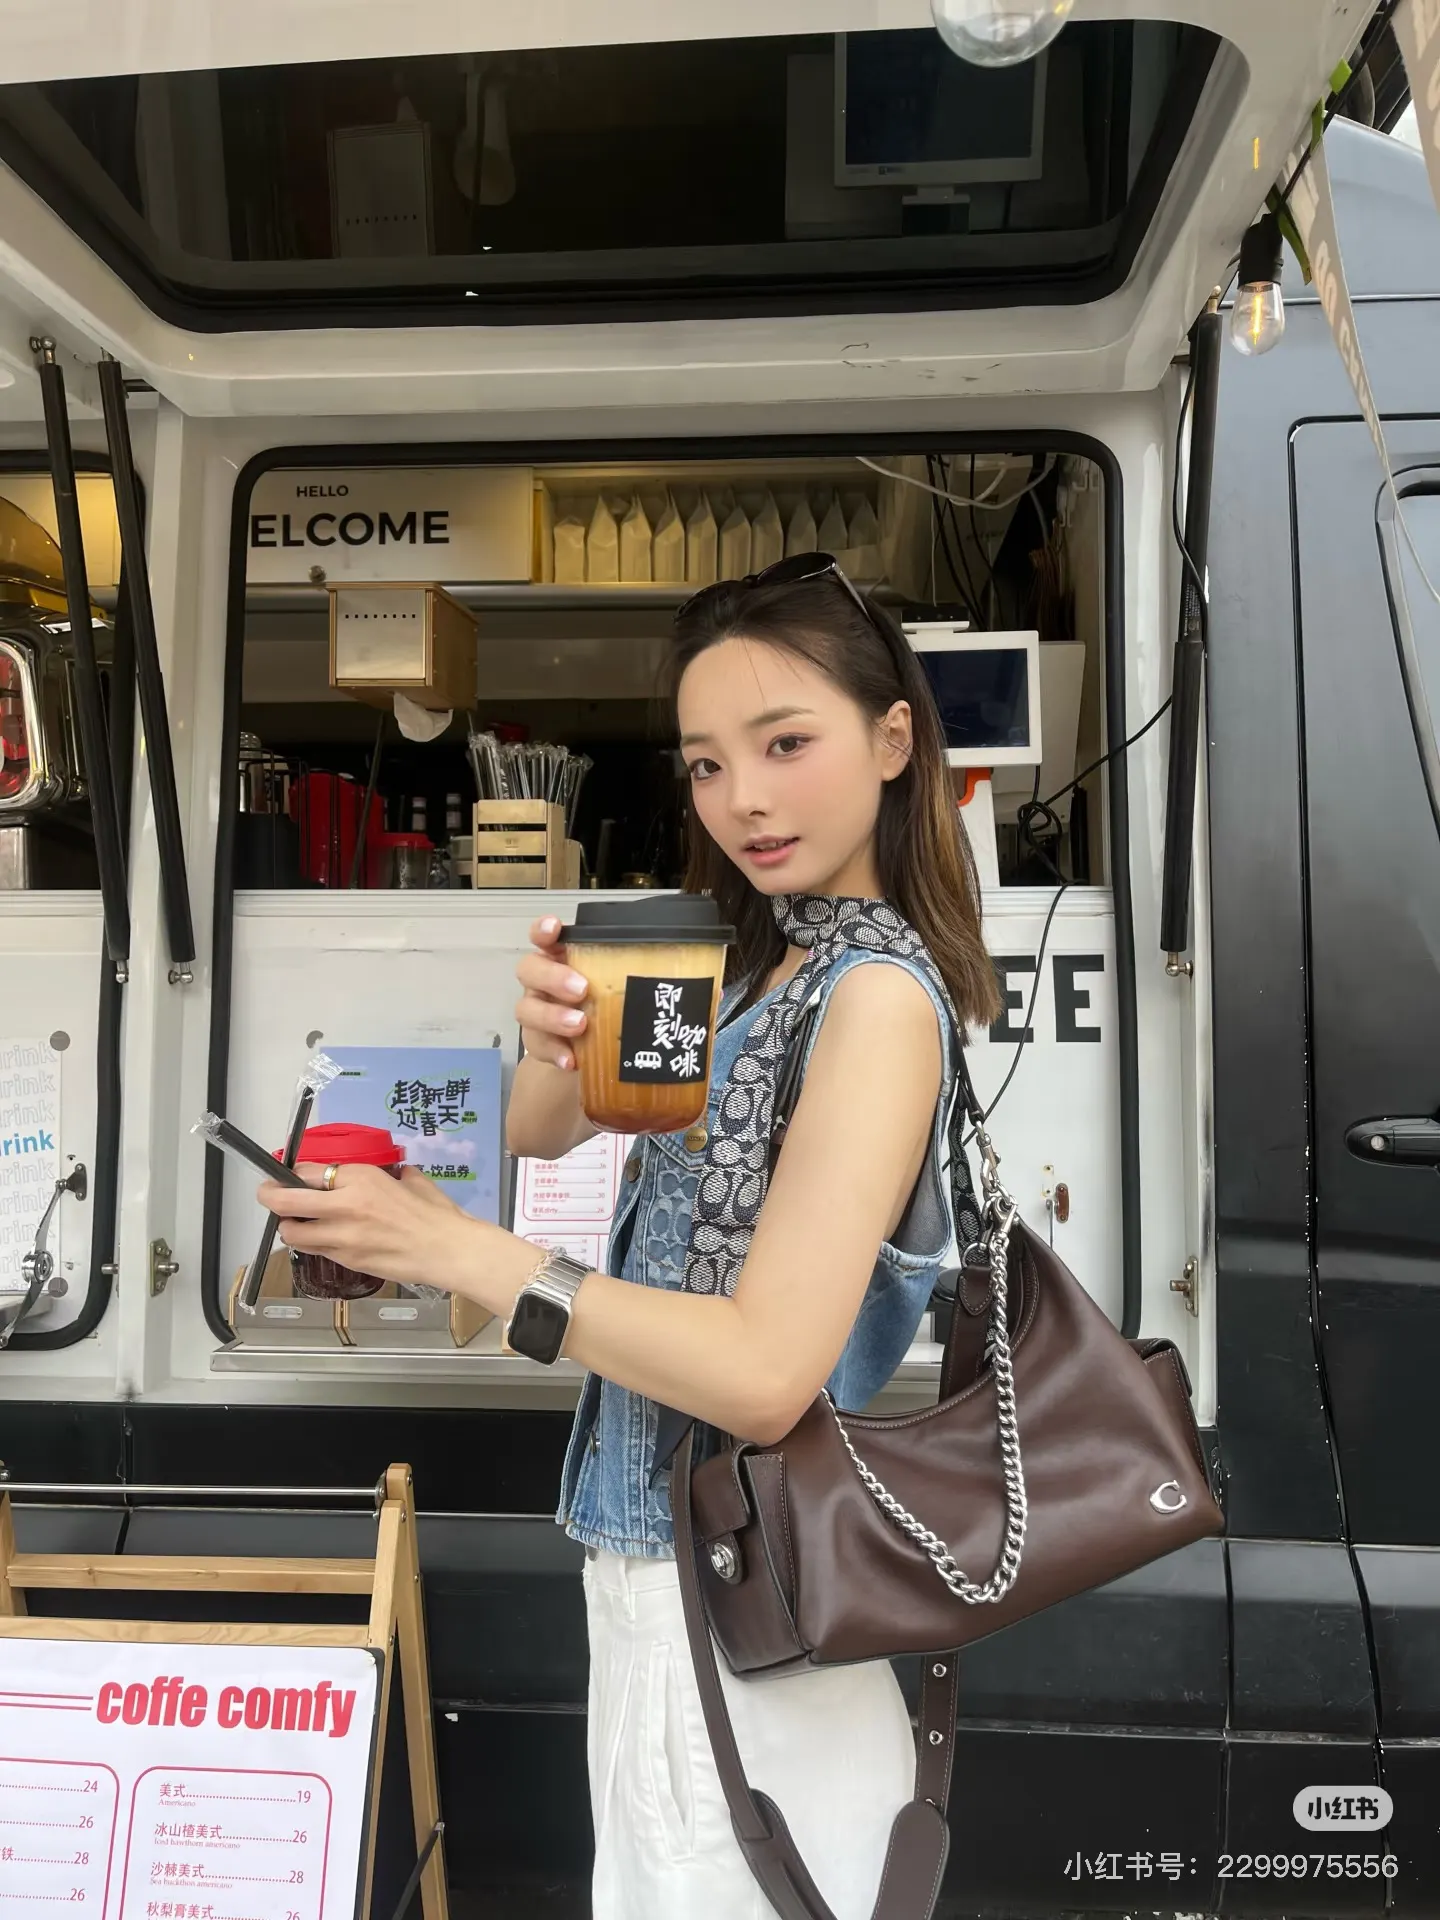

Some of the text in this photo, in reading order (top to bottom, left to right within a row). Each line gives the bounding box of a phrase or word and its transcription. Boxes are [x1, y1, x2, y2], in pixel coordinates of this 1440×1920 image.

[296, 484, 350, 498] HELLO
[651, 982, 684, 1050] 即刻
[0, 1041, 58, 1070] rink
[668, 1023, 708, 1079] 咖啡
[0, 1070, 56, 1099] rink
[0, 1099, 56, 1128] rink
[397, 1105, 459, 1137] 过春天
[0, 1129, 55, 1156] rink
[0, 1157, 56, 1187] rink
[96, 1675, 357, 1738] coffe comfy
[83, 1780, 98, 1793] 24
[159, 1782, 311, 1804] 美式 19
[158, 1799, 196, 1807] Americano
[79, 1816, 94, 1829] 26
[154, 1821, 308, 1844] 冰山楂美式 26
[73, 1851, 89, 1865] 28
[151, 1861, 304, 1884] 沙棘美式 28
[69, 1888, 85, 1901] 26
[146, 1902, 301, 1920] 秋梨膏美式 26
